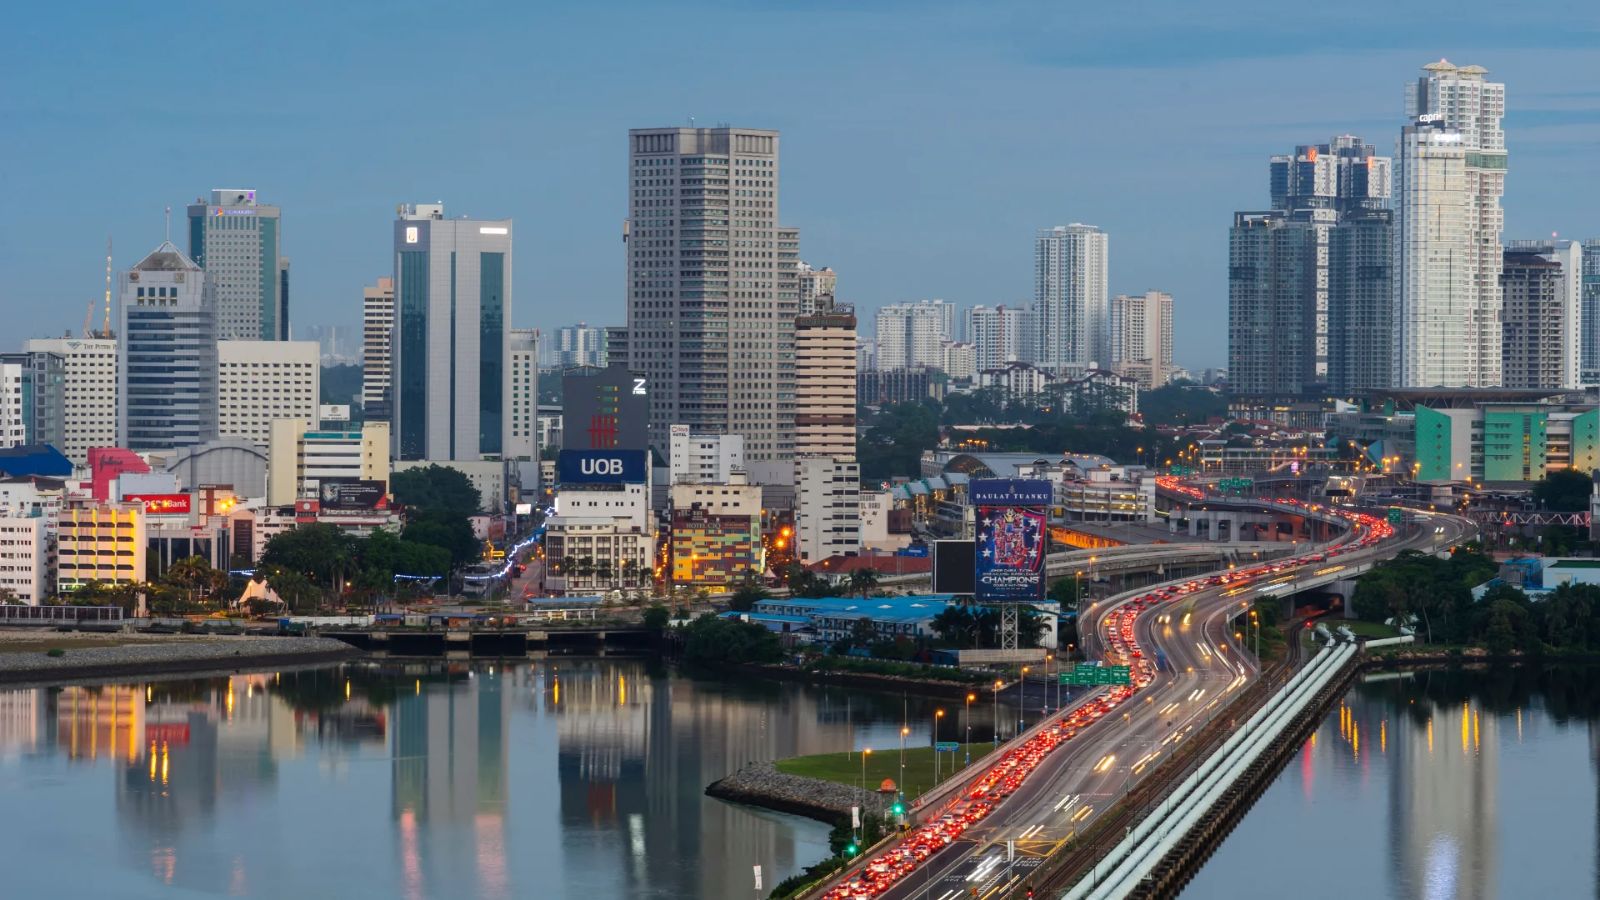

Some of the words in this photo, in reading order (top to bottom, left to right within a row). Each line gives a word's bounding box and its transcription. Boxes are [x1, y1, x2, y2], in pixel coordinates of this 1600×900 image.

[633, 378, 646, 391] Z
[581, 458, 623, 475] UOB
[167, 499, 187, 508] Bank
[981, 576, 1040, 585] CHAMPIONS
